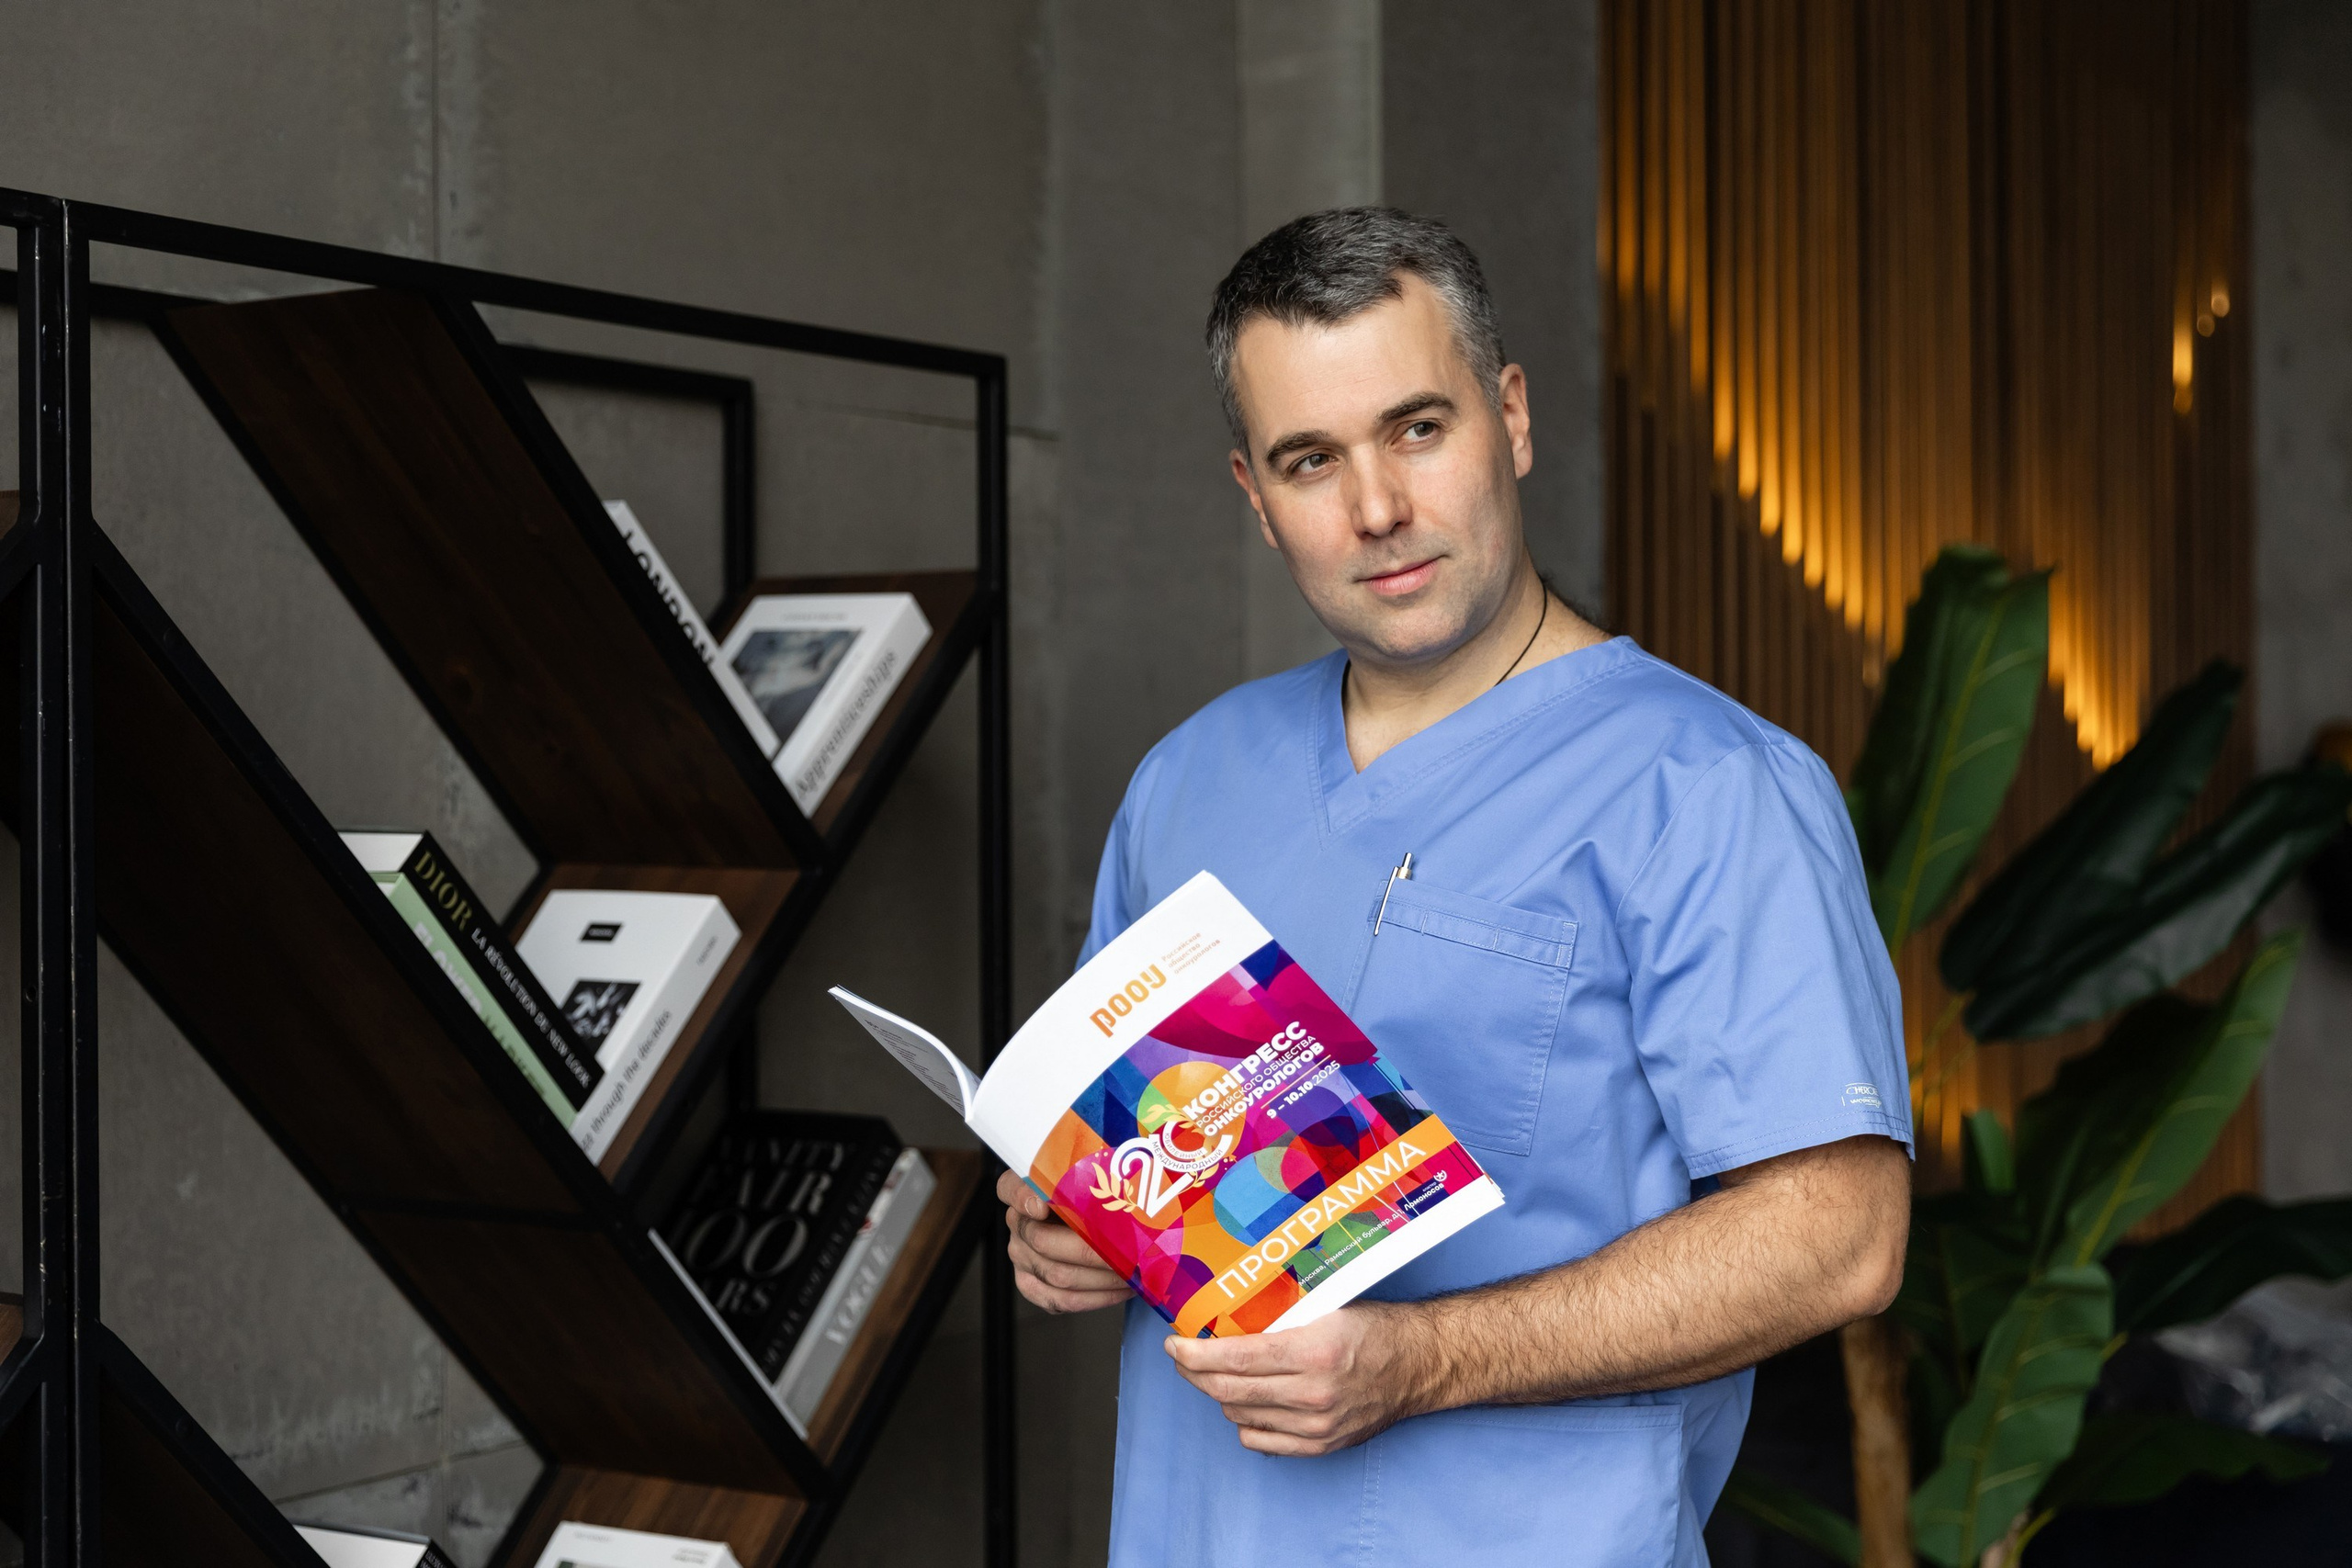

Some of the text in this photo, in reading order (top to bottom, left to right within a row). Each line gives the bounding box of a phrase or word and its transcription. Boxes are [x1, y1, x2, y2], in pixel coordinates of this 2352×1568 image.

[414, 851, 473, 931] DIOR
[471, 927, 488, 951] LA
[547, 1028, 571, 1057] NEW
[564, 1053, 592, 1089] LOOK
[1161, 932, 1202, 962] Российское
[1168, 942, 1201, 968] общество
[1174, 939, 1221, 975] онкоурологов
[1182, 1021, 1306, 1121] КОНГРЕСС
[1195, 1035, 1316, 1129] РОССИЙСКОГО ОБЩЕСТВА
[1204, 1042, 1325, 1136] ОНКОУРОЛОГОВ
[1266, 1108, 1278, 1120] 9
[1283, 1060, 1340, 1106] 10.10.2025
[1152, 1141, 1224, 1171] МЕЖДУНАРОДНЫЙ
[1164, 1132, 1204, 1160] ЮБИЛЕЙНЫЙ
[1216, 1141, 1427, 1299] ПРОГРАММА
[1404, 1182, 1445, 1212] Ломоносов
[1297, 1263, 1327, 1287] Москва,
[1325, 1235, 1363, 1266] Раменский
[1362, 1216, 1393, 1238] бульвар,
